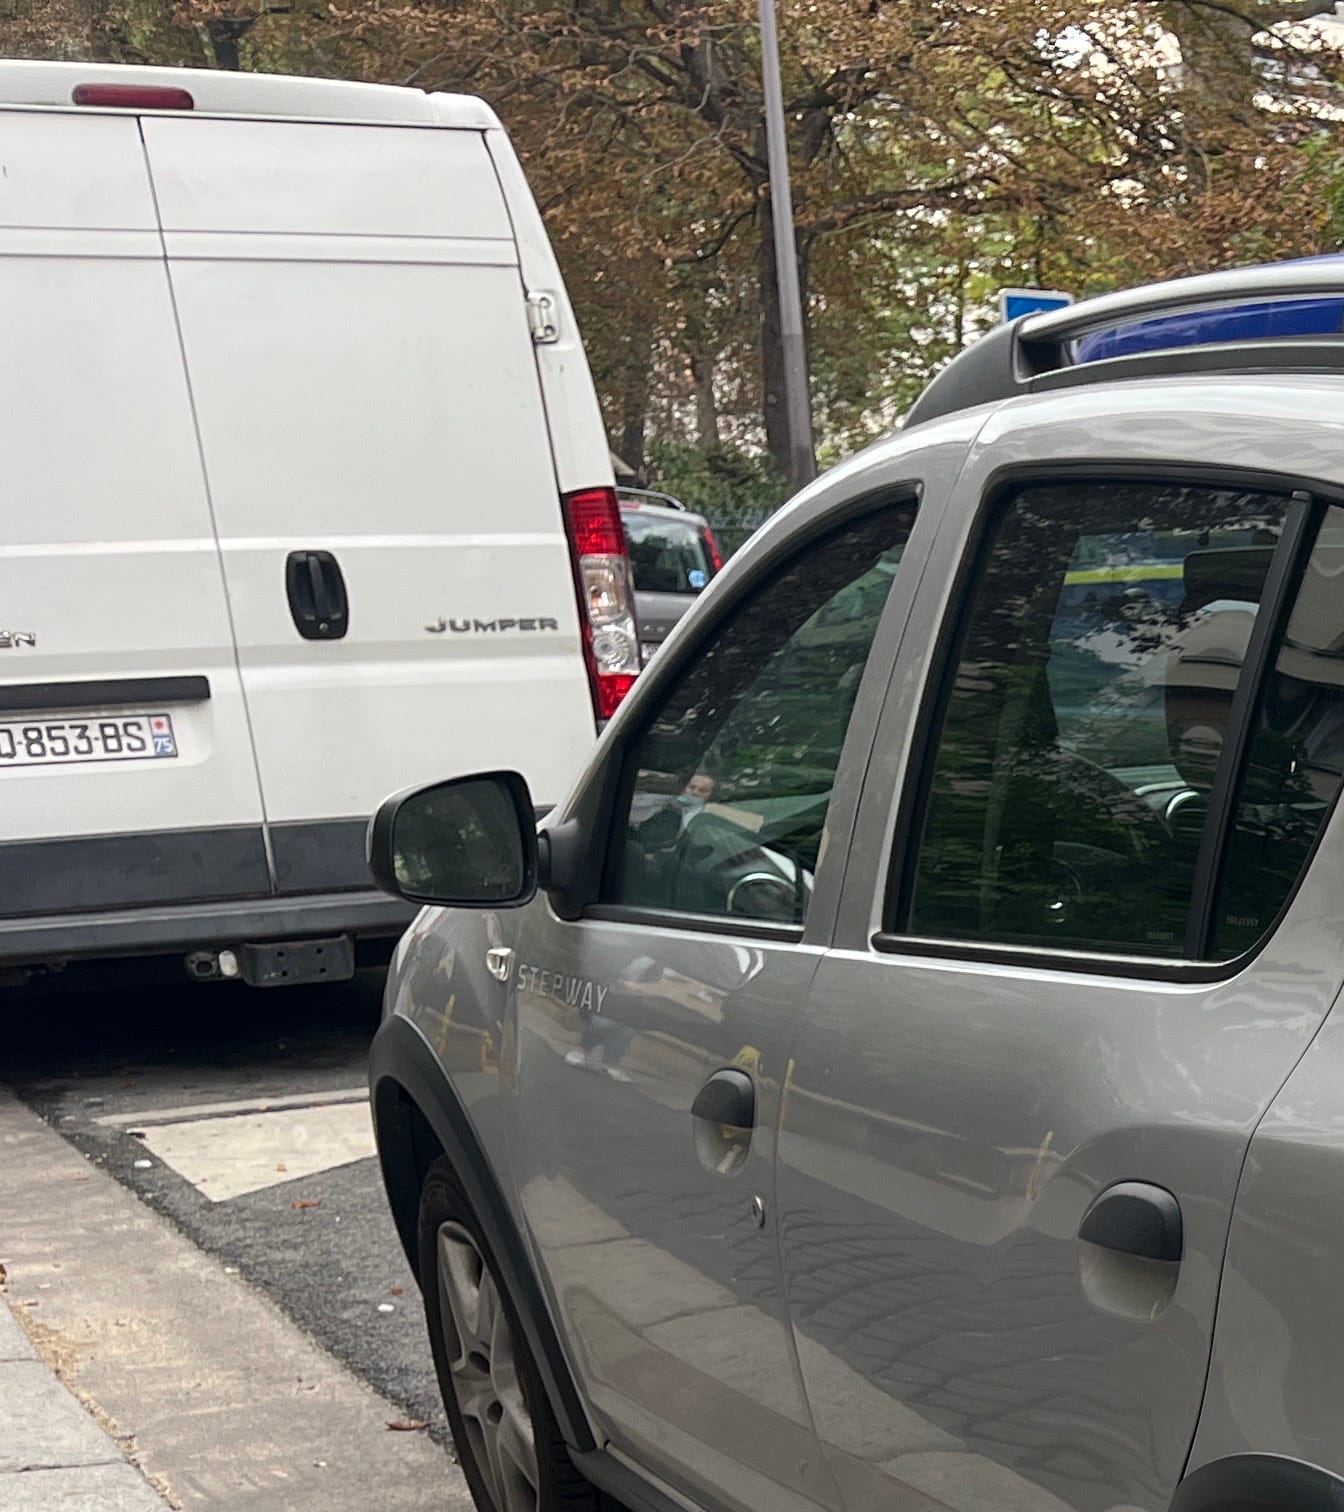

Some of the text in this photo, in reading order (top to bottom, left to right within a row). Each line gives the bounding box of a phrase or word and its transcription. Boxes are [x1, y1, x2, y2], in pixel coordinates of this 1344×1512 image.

[424, 617, 559, 633] JUMPER
[154, 738, 173, 753] 75
[517, 964, 608, 1013] STEPWAY
